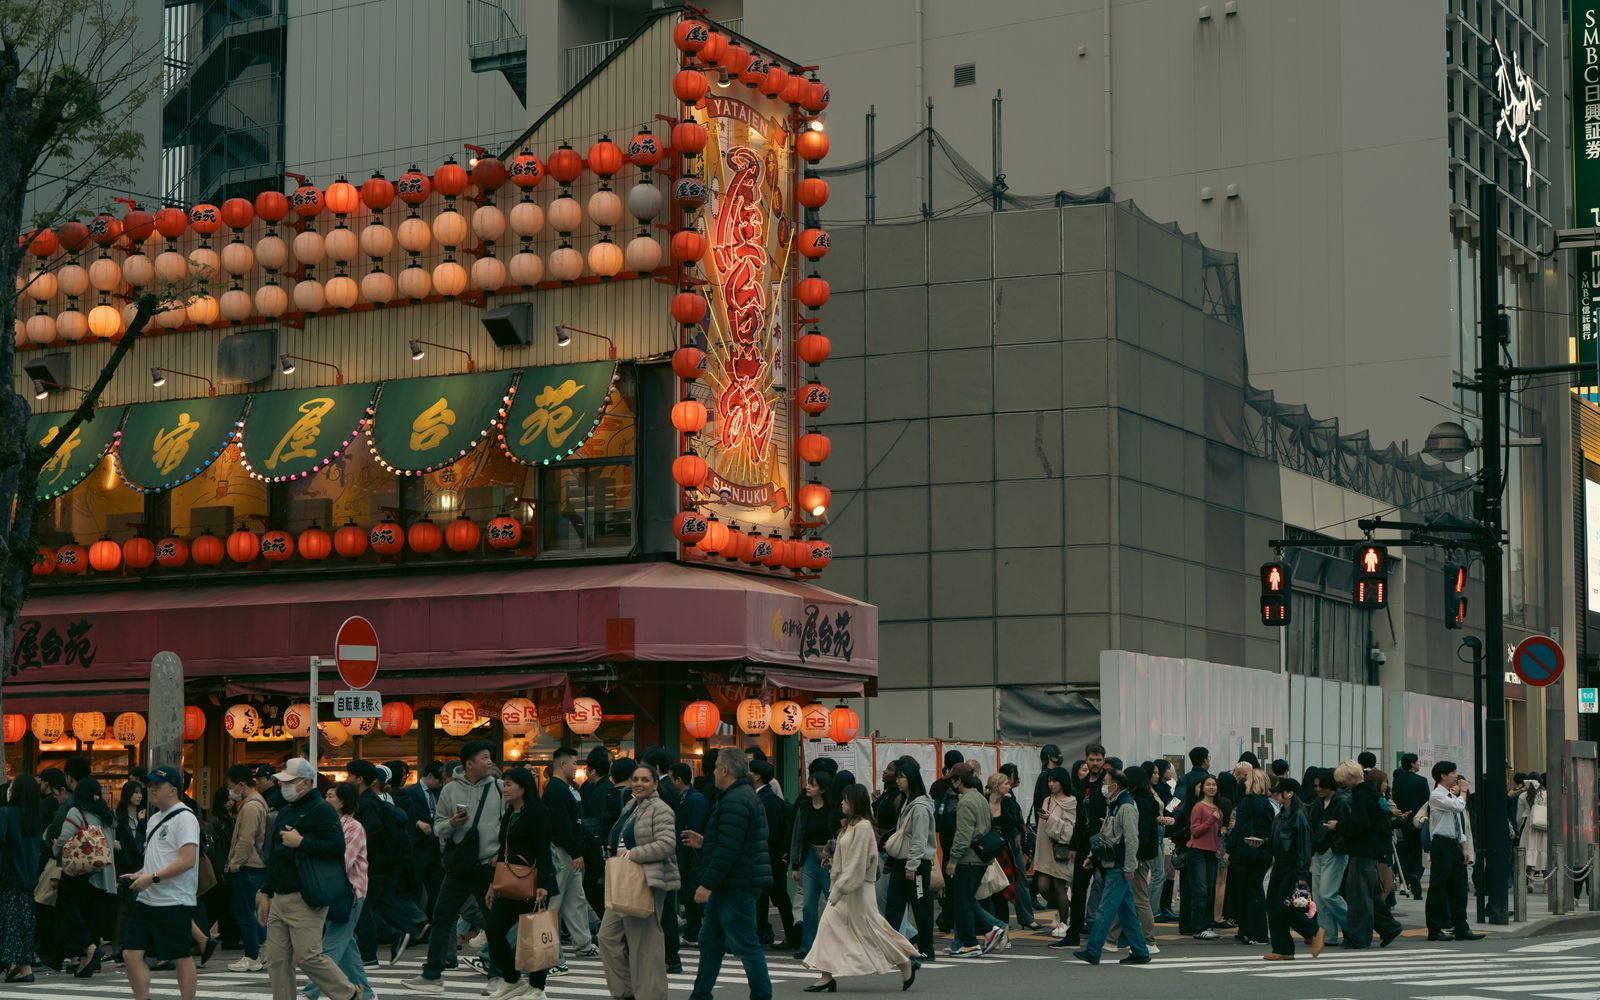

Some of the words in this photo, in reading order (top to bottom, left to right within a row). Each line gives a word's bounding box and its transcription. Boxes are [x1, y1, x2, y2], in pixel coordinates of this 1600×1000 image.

[714, 99, 769, 137] YATAIEN
[10, 619, 98, 676] 屋台苑
[337, 696, 380, 712] 自転車を除く
[452, 708, 474, 720] RS
[503, 712, 521, 723] RS
[568, 711, 588, 722] RS
[781, 705, 795, 732] くろ松
[805, 717, 826, 728] RS
[541, 931, 553, 945] GU
